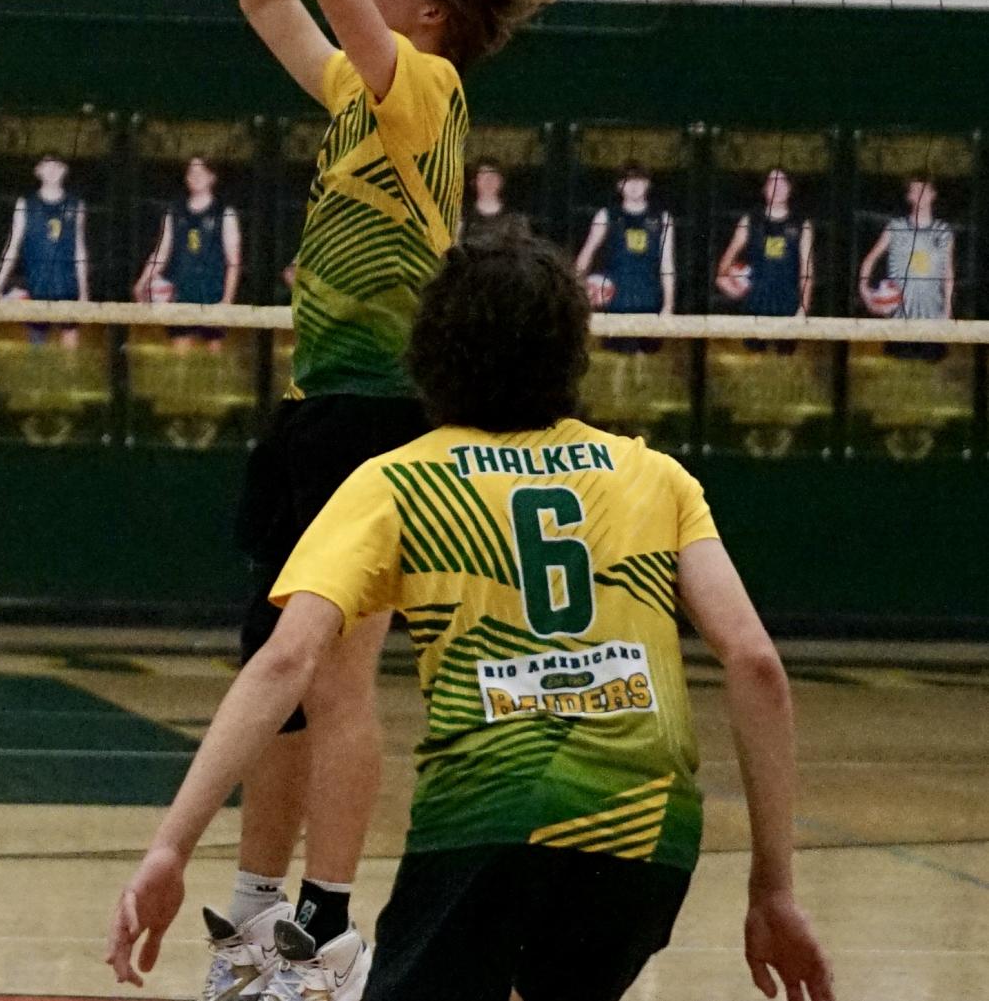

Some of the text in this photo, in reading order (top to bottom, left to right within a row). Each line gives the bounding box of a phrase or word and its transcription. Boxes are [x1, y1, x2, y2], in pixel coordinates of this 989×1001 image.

[450, 442, 614, 478] THALKEN
[510, 484, 595, 638] 6
[483, 664, 518, 680] RIO
